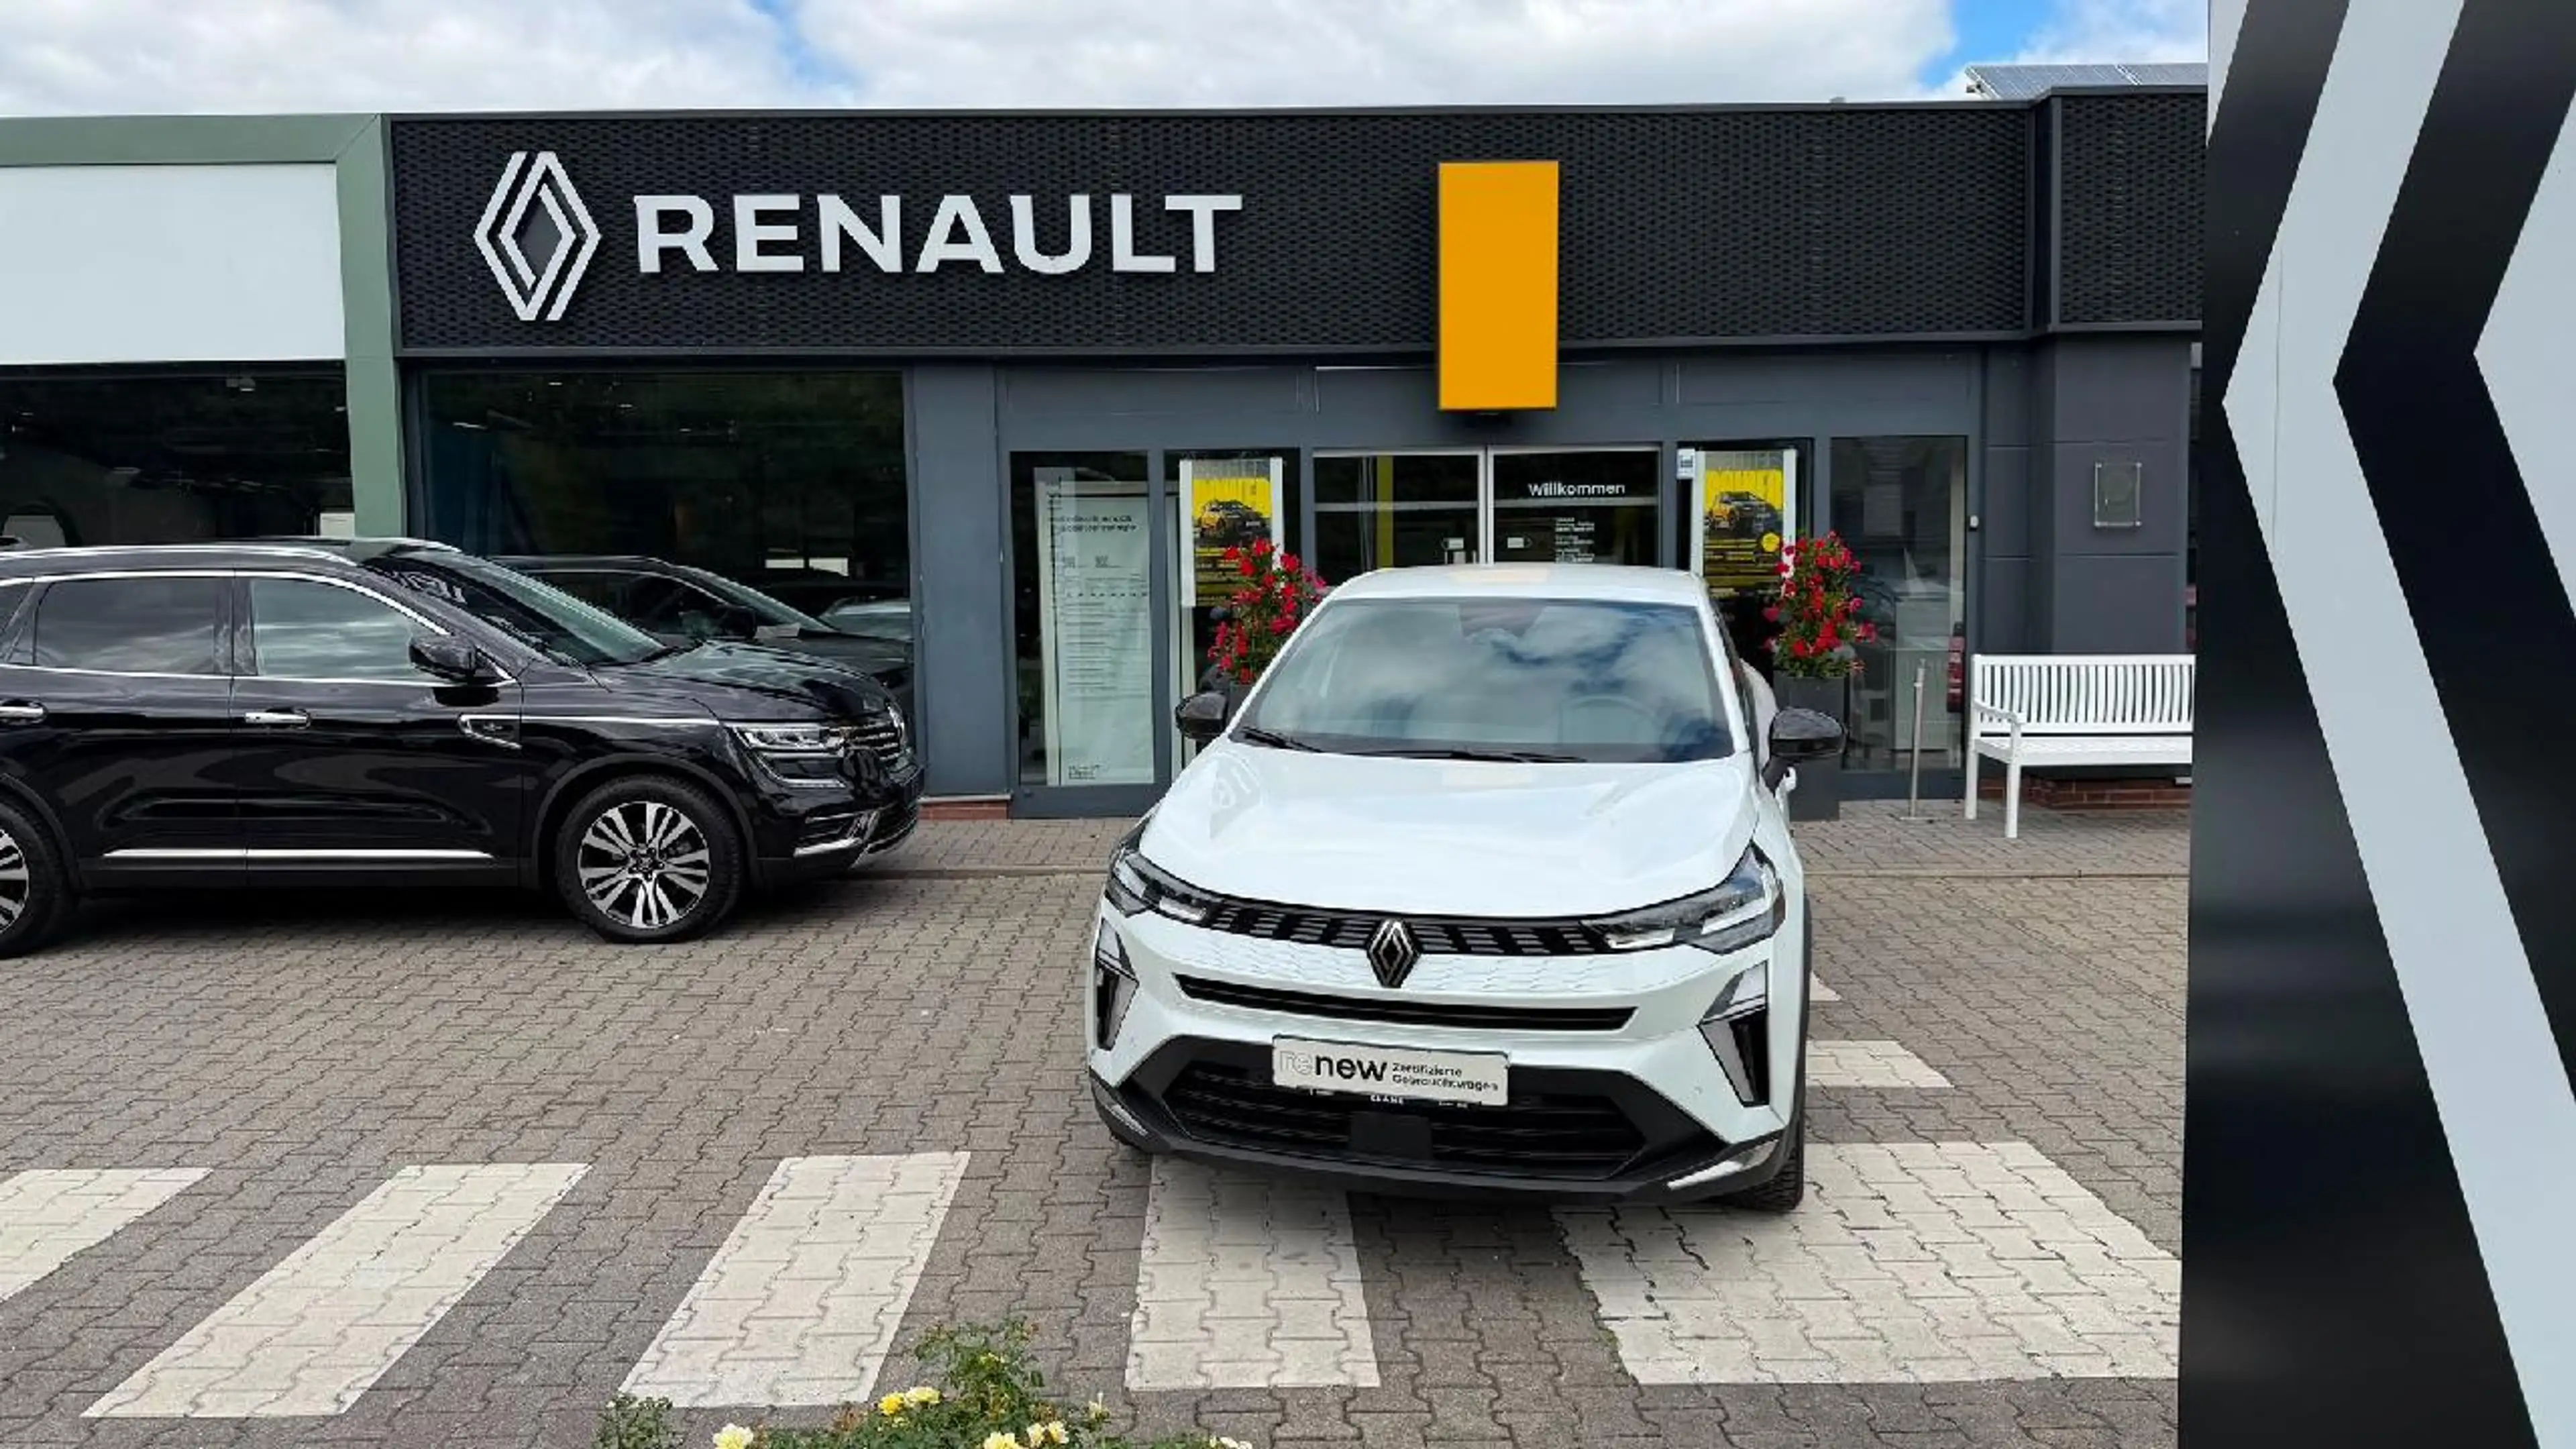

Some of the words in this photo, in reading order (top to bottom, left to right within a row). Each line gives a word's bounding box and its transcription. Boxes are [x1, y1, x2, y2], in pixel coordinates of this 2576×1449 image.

[633, 193, 1243, 274] RENAULT
[1527, 481, 1626, 496] Willkommen
[1279, 1049, 1388, 1081] renew
[1392, 1062, 1462, 1077] Zertifizierte
